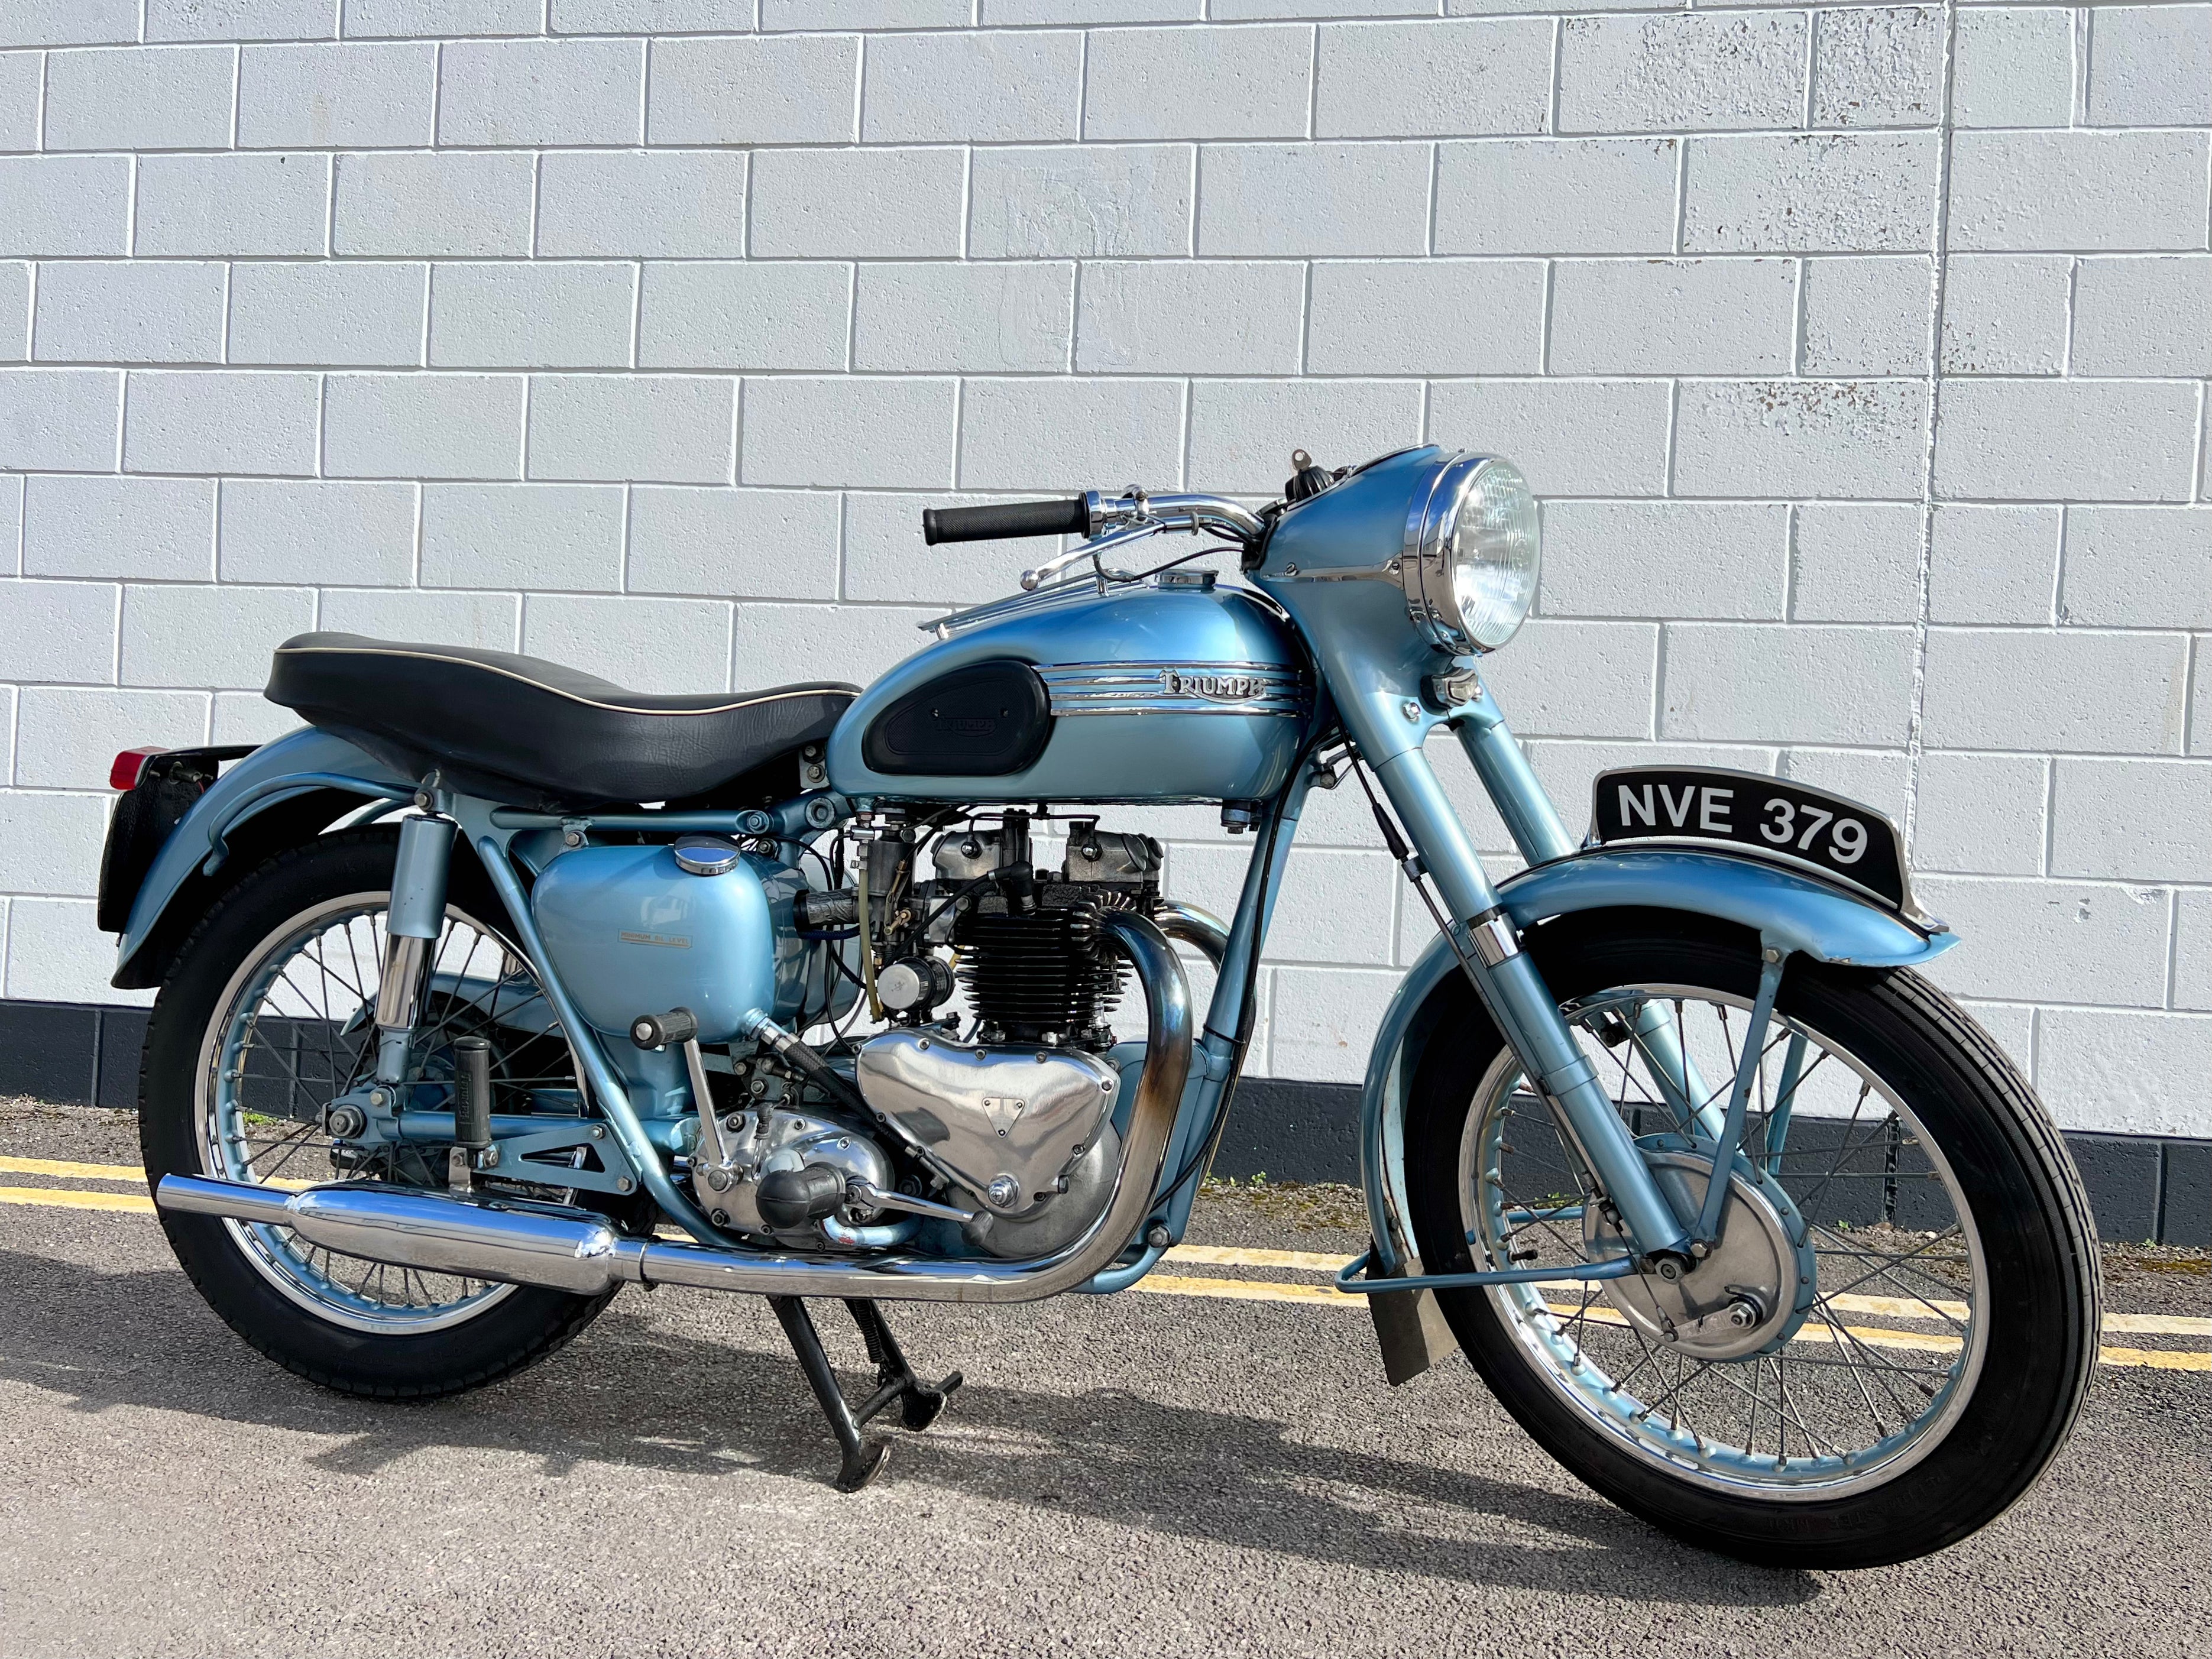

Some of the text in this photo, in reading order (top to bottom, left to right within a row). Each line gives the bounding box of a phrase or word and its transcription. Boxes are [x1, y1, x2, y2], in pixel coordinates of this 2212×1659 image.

[1159, 669, 1266, 696] TRIUMPH
[1617, 784, 1868, 864] NVE 379
